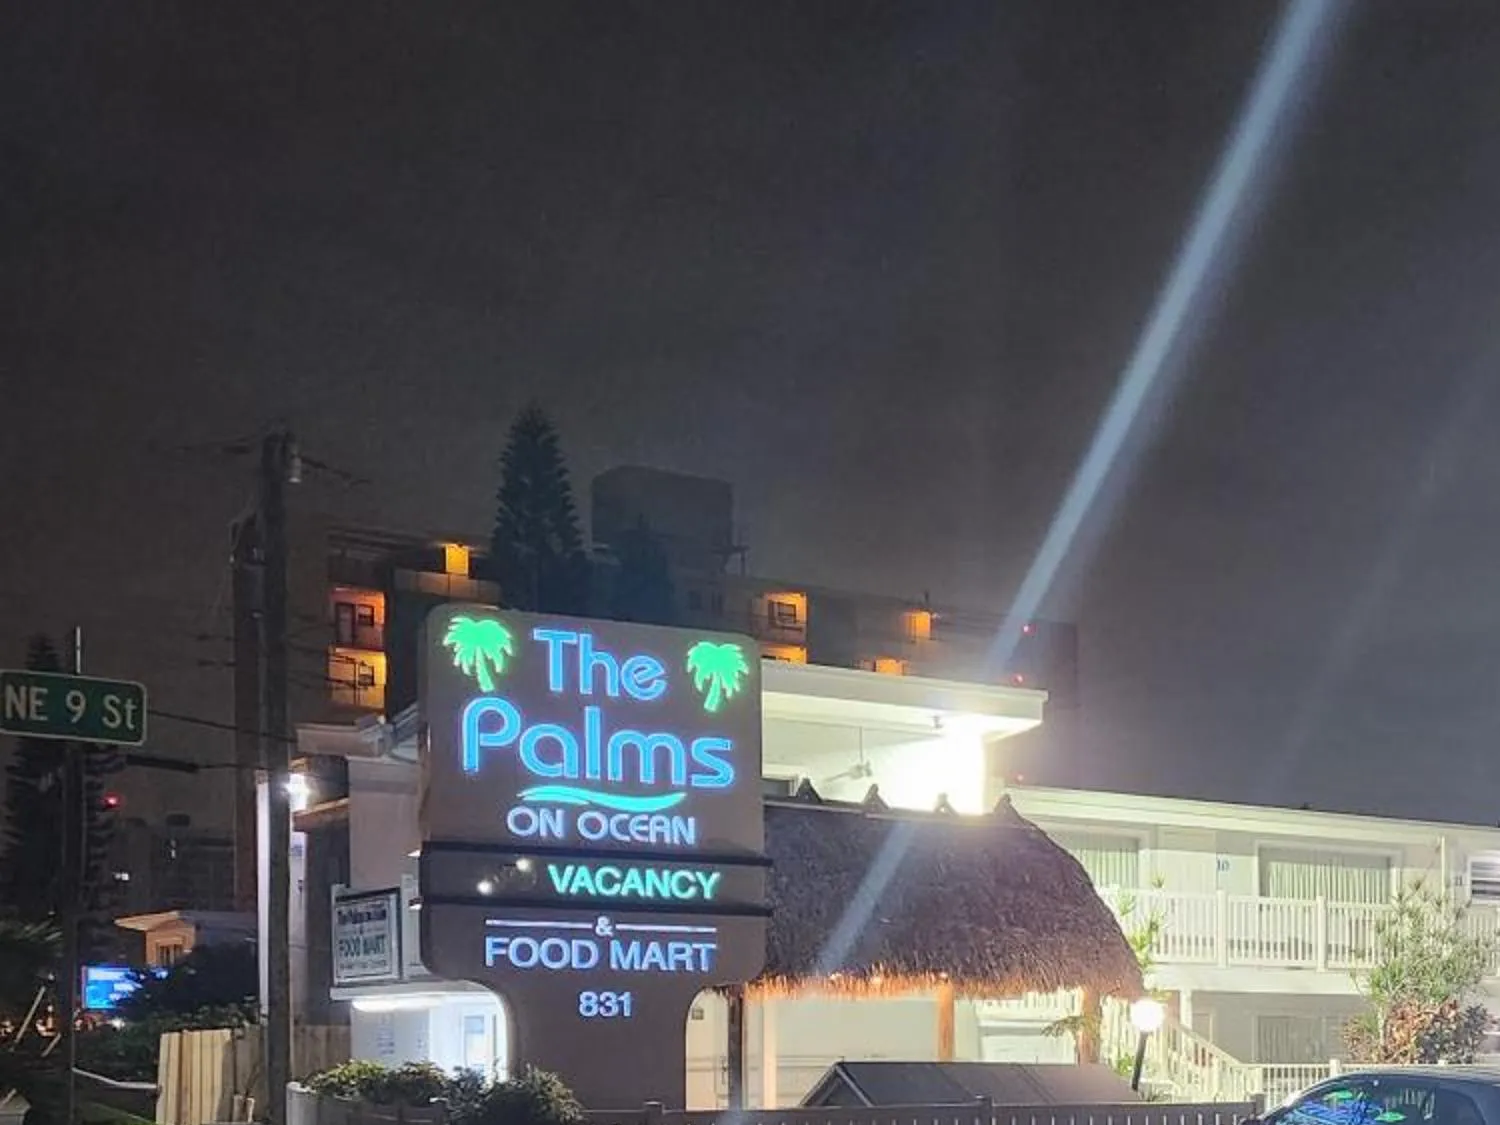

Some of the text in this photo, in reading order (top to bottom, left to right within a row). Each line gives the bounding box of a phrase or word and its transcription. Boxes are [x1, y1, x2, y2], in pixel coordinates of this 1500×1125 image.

[533, 628, 668, 700] The
[5, 684, 137, 729] NE 9 St
[462, 697, 735, 788] Palms
[507, 806, 696, 844] ON OCEAN
[548, 865, 720, 899] VACANCY
[595, 916, 614, 937] &
[484, 937, 717, 972] FOOD MART
[579, 991, 632, 1017] 831
